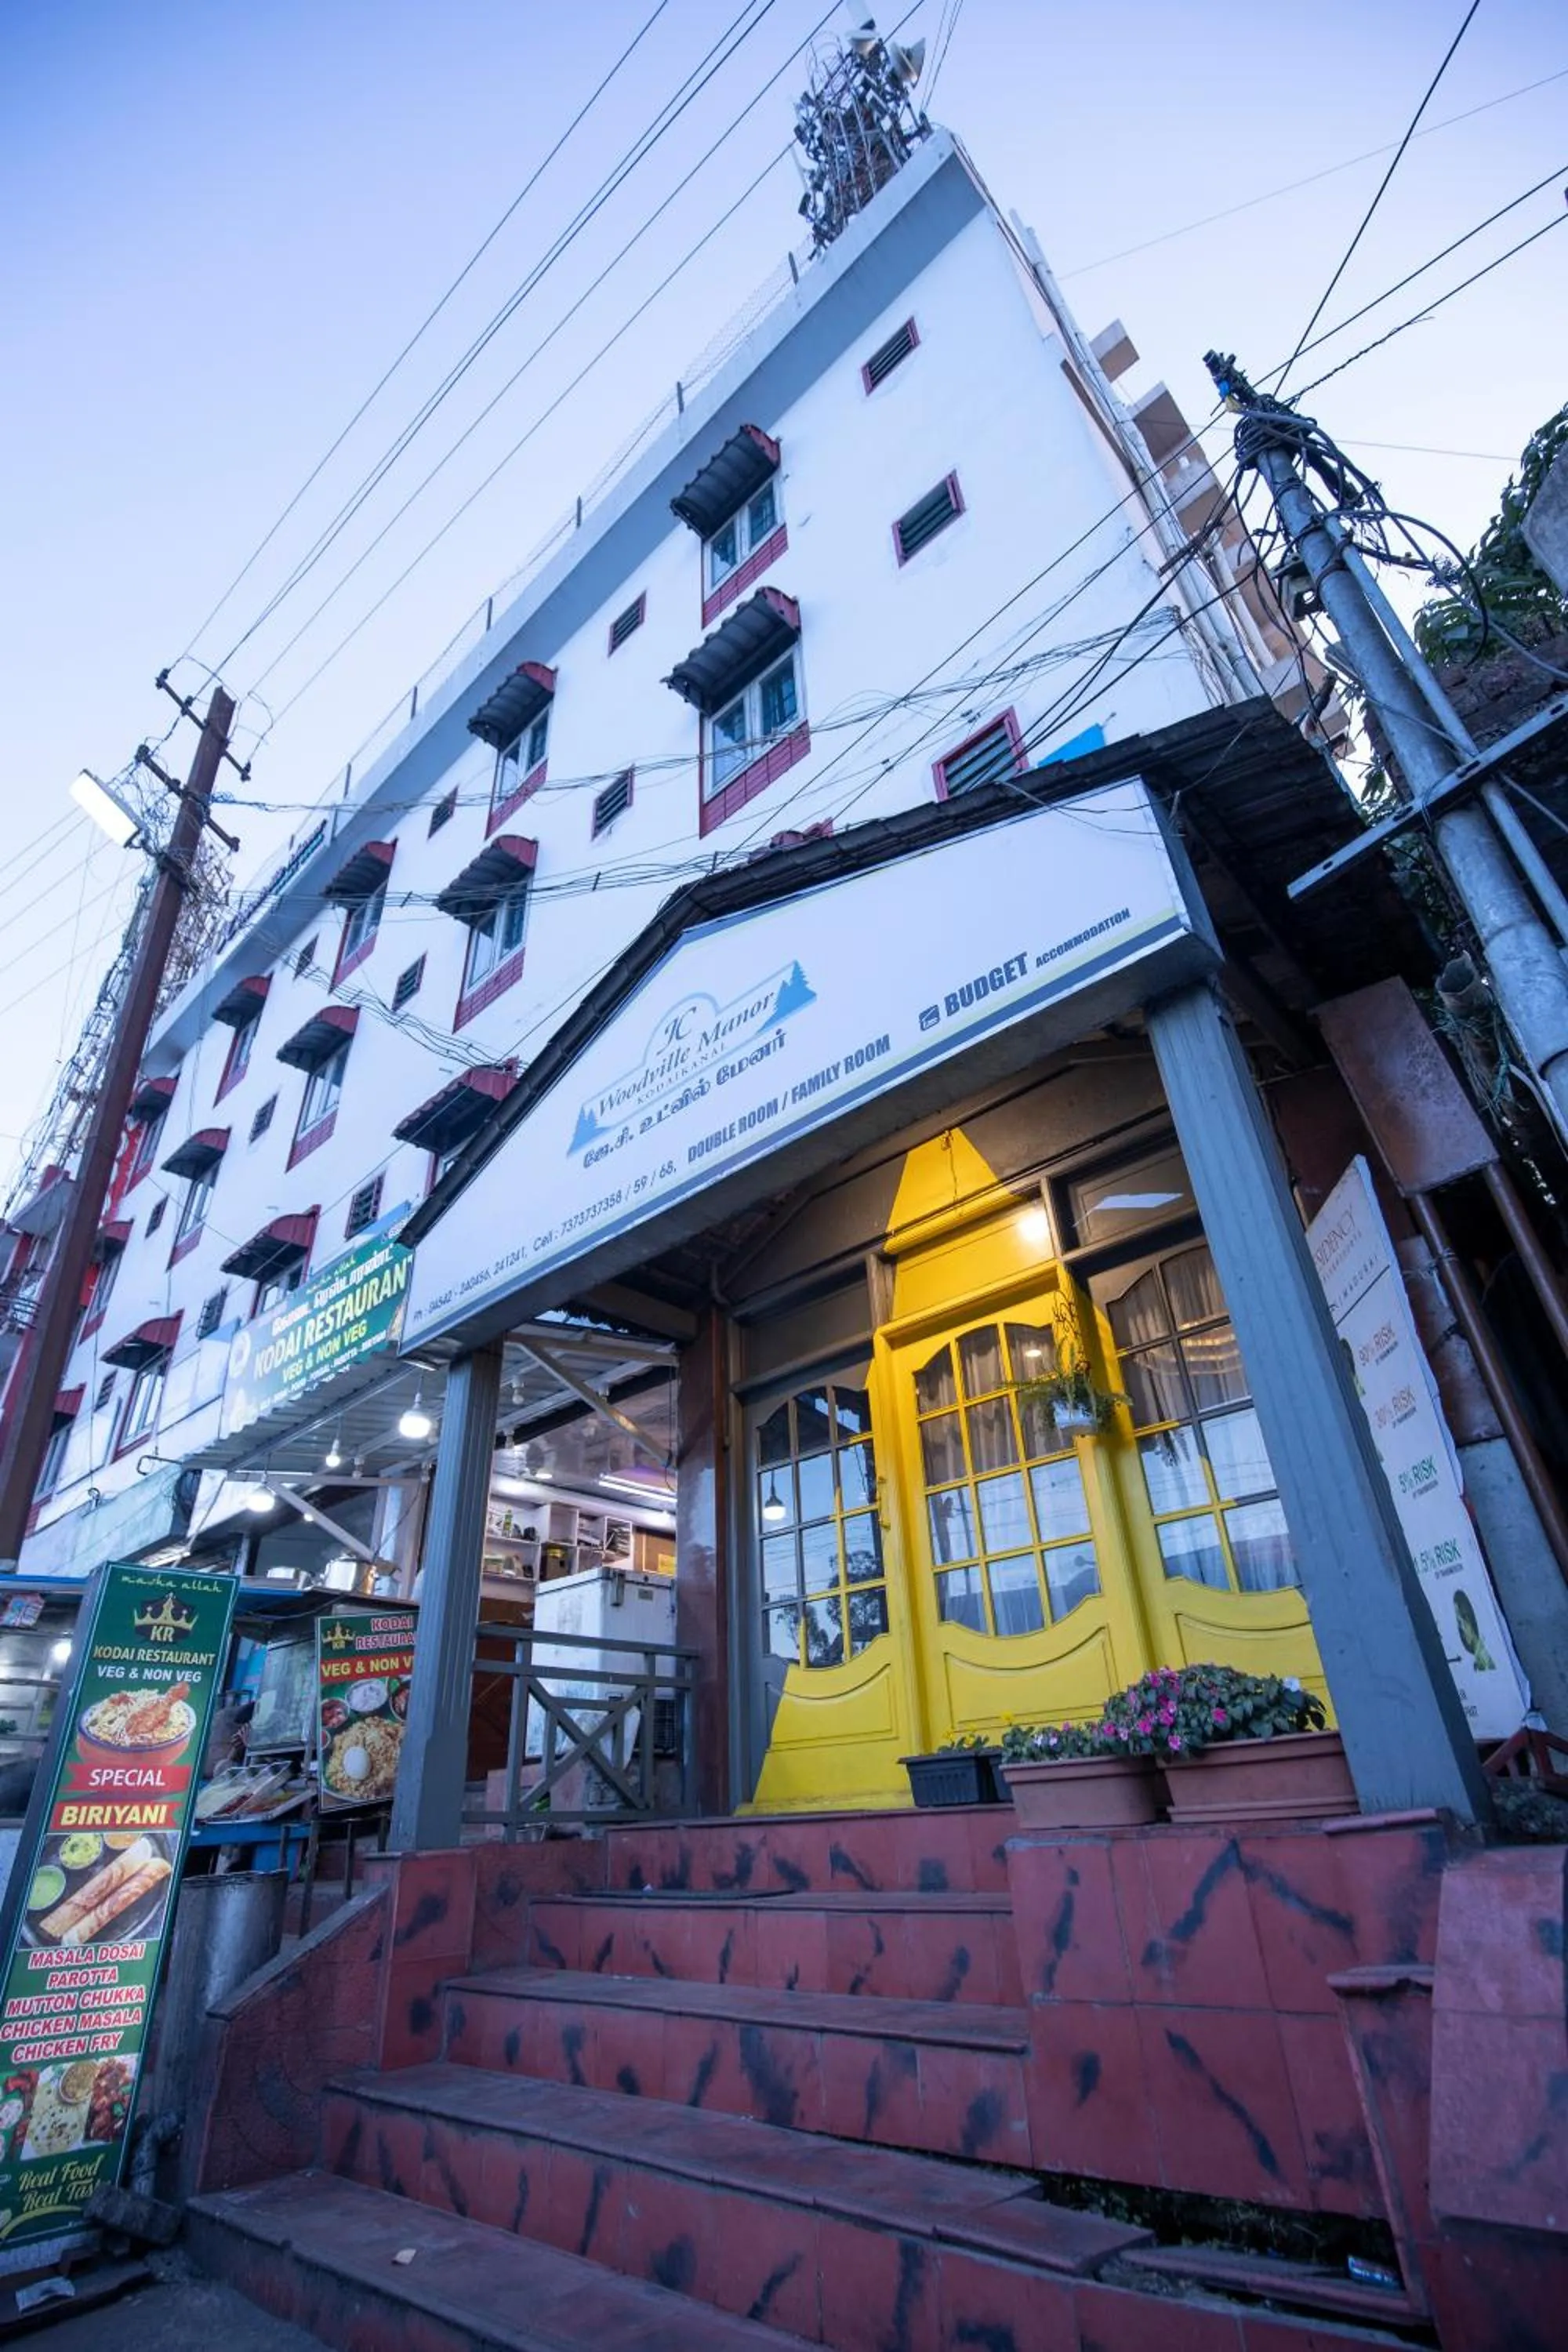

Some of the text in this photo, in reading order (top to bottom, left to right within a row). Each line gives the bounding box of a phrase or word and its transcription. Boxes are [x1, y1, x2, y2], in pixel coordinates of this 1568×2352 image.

[943, 907, 1131, 1017] BUDGET ACCOMMODATION
[600, 992, 775, 1116] Woodville Manor
[688, 1122, 736, 1163] DOUBLE
[738, 1098, 779, 1136] ROOM
[791, 1062, 841, 1105] FAMILY
[844, 1033, 891, 1075] ROOM
[633, 1174, 648, 1195] 59
[282, 1358, 303, 1383] VEG
[316, 1334, 342, 1364] NON
[343, 1319, 368, 1346] VEG
[1412, 1454, 1439, 1484] RISK
[1434, 1537, 1462, 1565] RISK
[181, 1580, 223, 1593] allah
[150, 1624, 176, 1643] KR
[371, 1615, 415, 1632] KODAI
[355, 1632, 416, 1650] RESTAURA
[93, 1646, 216, 1666] KODAI RESTAURANT
[321, 1661, 351, 1678] VEG
[355, 1661, 366, 1675] &
[369, 1656, 400, 1672] NON
[97, 1664, 202, 1683] VEG & NON VEG
[88, 1768, 166, 1788] SPECIAL
[60, 1803, 169, 1827] BIRIYANI
[28, 1942, 146, 1969] MASALA DOSAI
[47, 1966, 118, 1990] PAROTTA
[5, 1985, 146, 2017] MUTTON CHUKKA
[0, 2007, 143, 2041] CHICKEN MASALA
[13, 2031, 124, 2064] CHICKEN FRY
[18, 2153, 106, 2193] Real Food
[23, 2185, 63, 2212] Real
